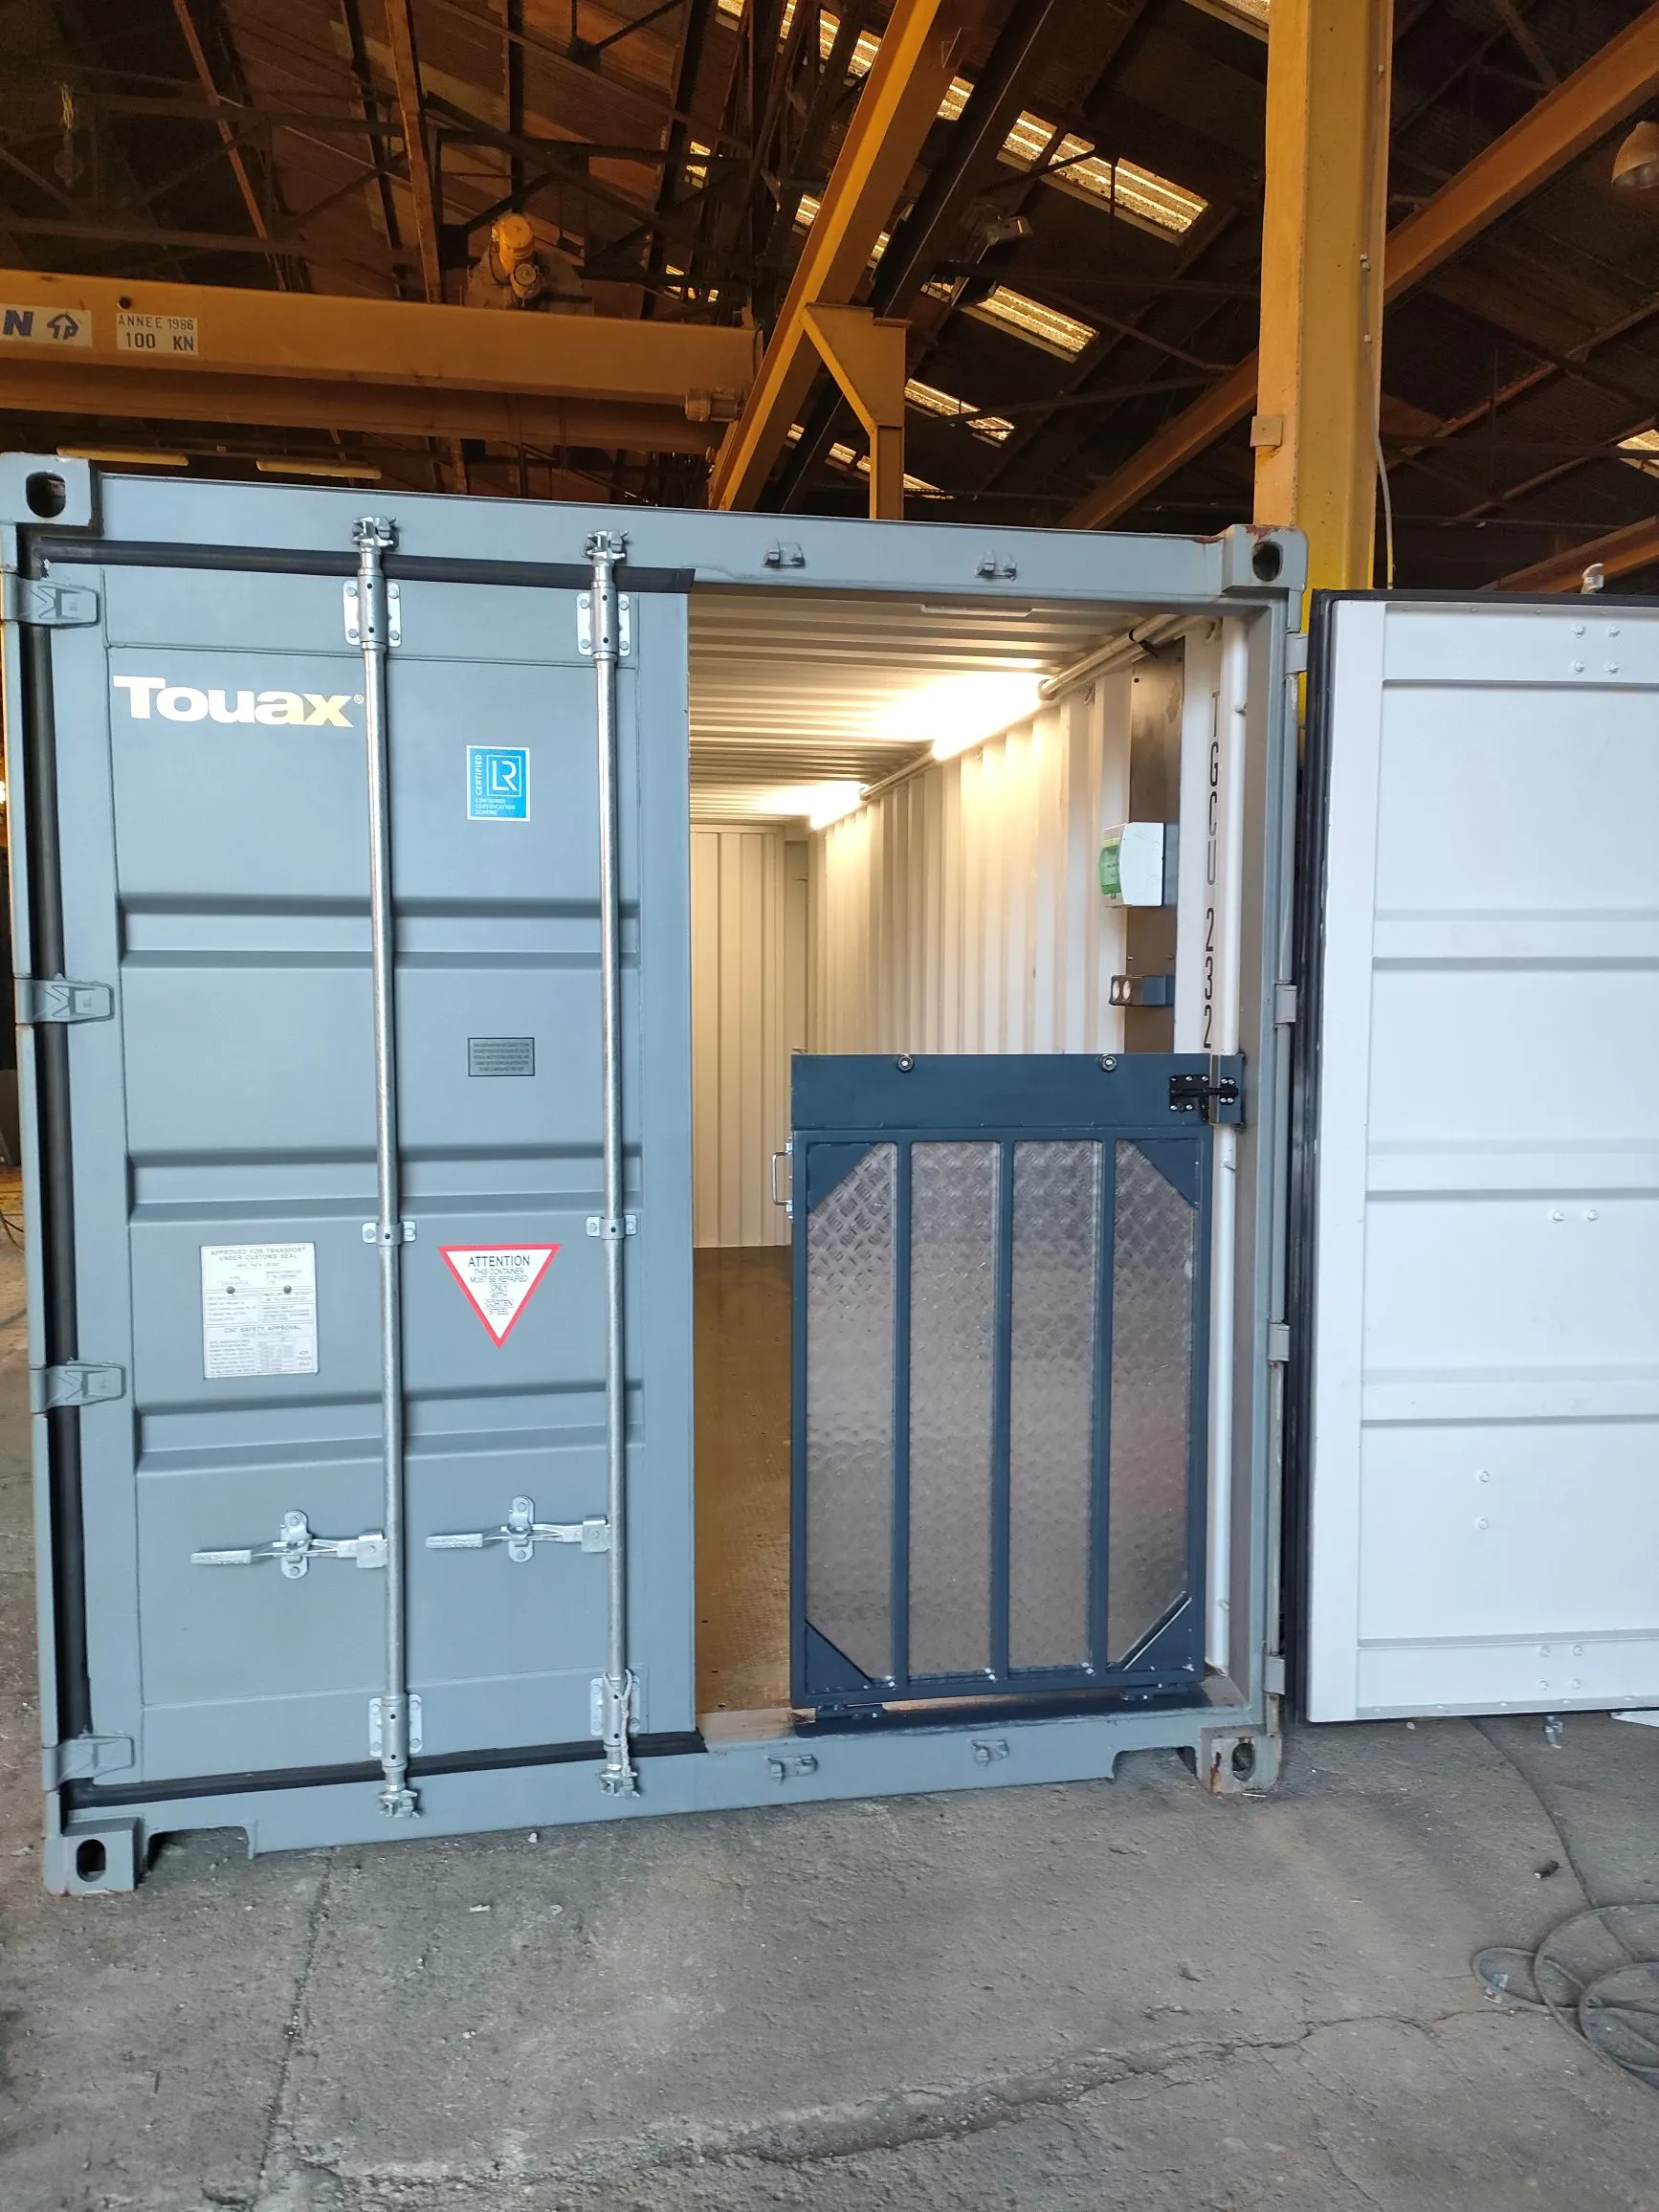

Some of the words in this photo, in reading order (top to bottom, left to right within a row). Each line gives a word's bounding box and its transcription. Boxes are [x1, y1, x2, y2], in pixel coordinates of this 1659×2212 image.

[167, 318, 195, 331] 1986
[125, 332, 157, 348] 100
[172, 335, 194, 352] KN
[491, 760, 519, 791] LR
[1206, 690, 1221, 886] TGCU
[468, 1255, 530, 1267] ATTENTION
[489, 1267, 525, 1275] CONTAINER
